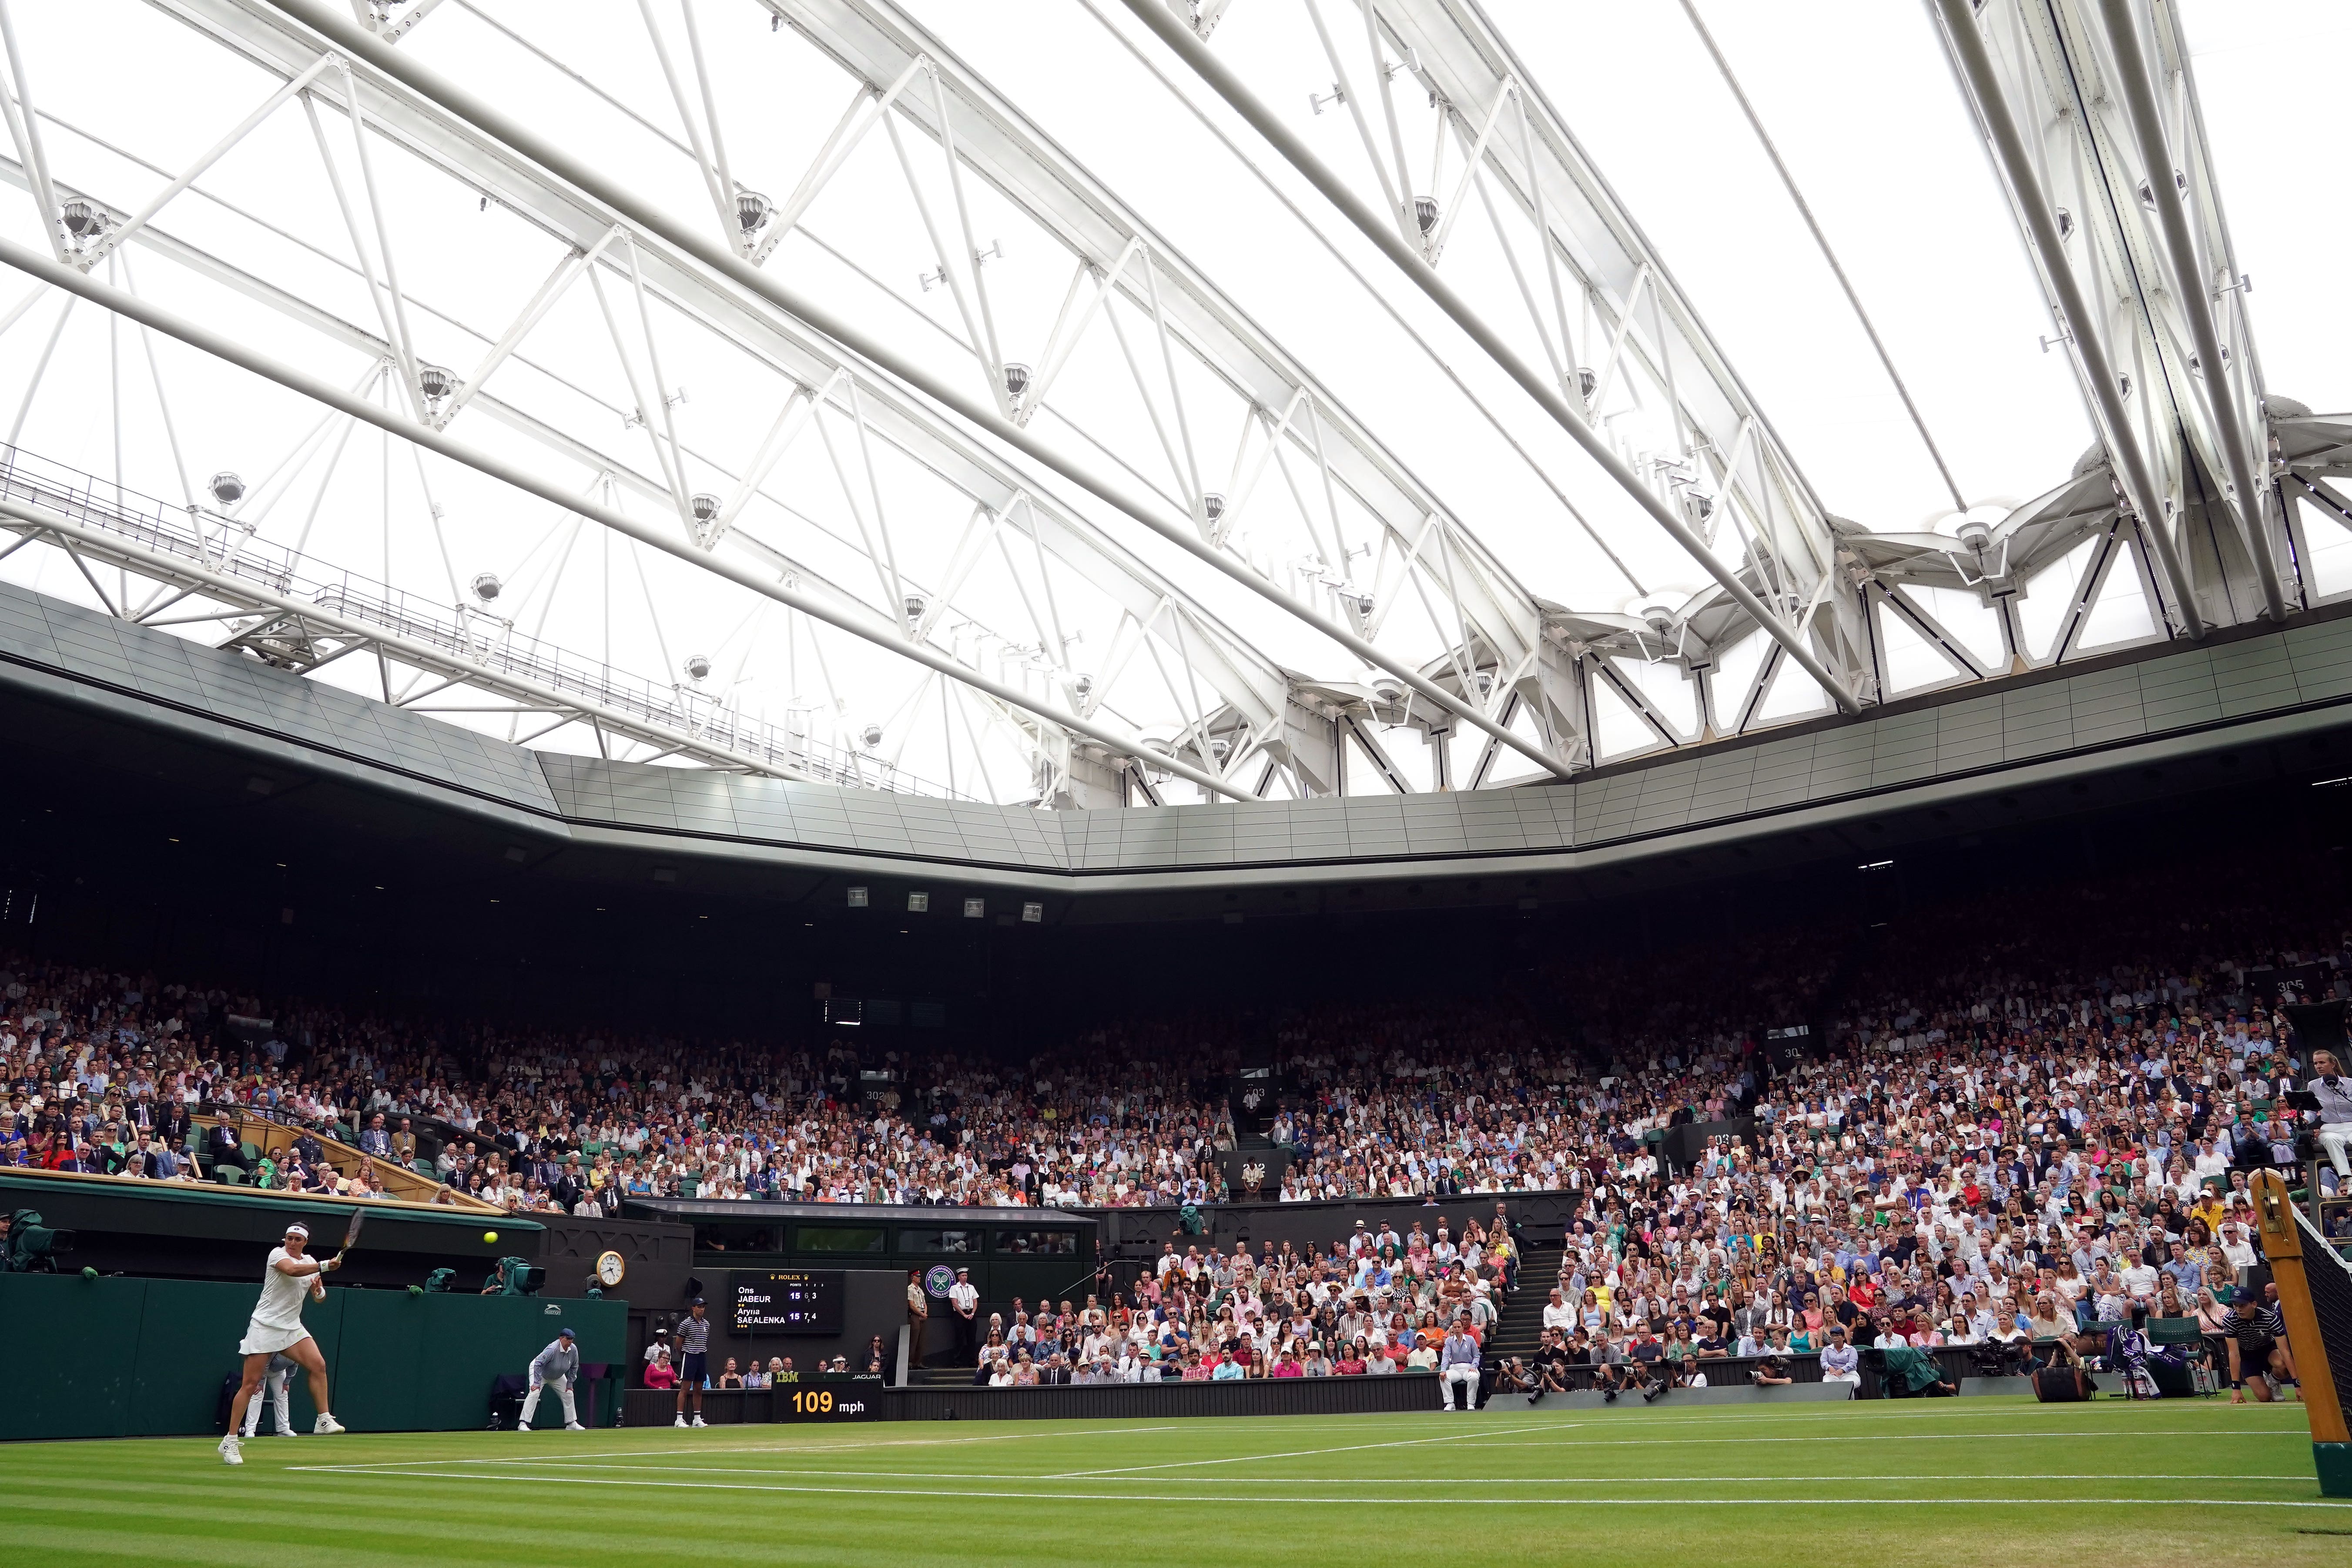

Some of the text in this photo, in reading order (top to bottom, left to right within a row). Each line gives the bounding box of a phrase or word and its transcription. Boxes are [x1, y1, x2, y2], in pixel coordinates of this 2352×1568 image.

[867, 1091, 885, 1100] 302
[1246, 1088, 1265, 1097] 03
[1708, 1134, 1729, 1146] 03
[1243, 1163, 1265, 1173] 22
[776, 1372, 798, 1383] IBM
[792, 1391, 864, 1414] 109 mph
